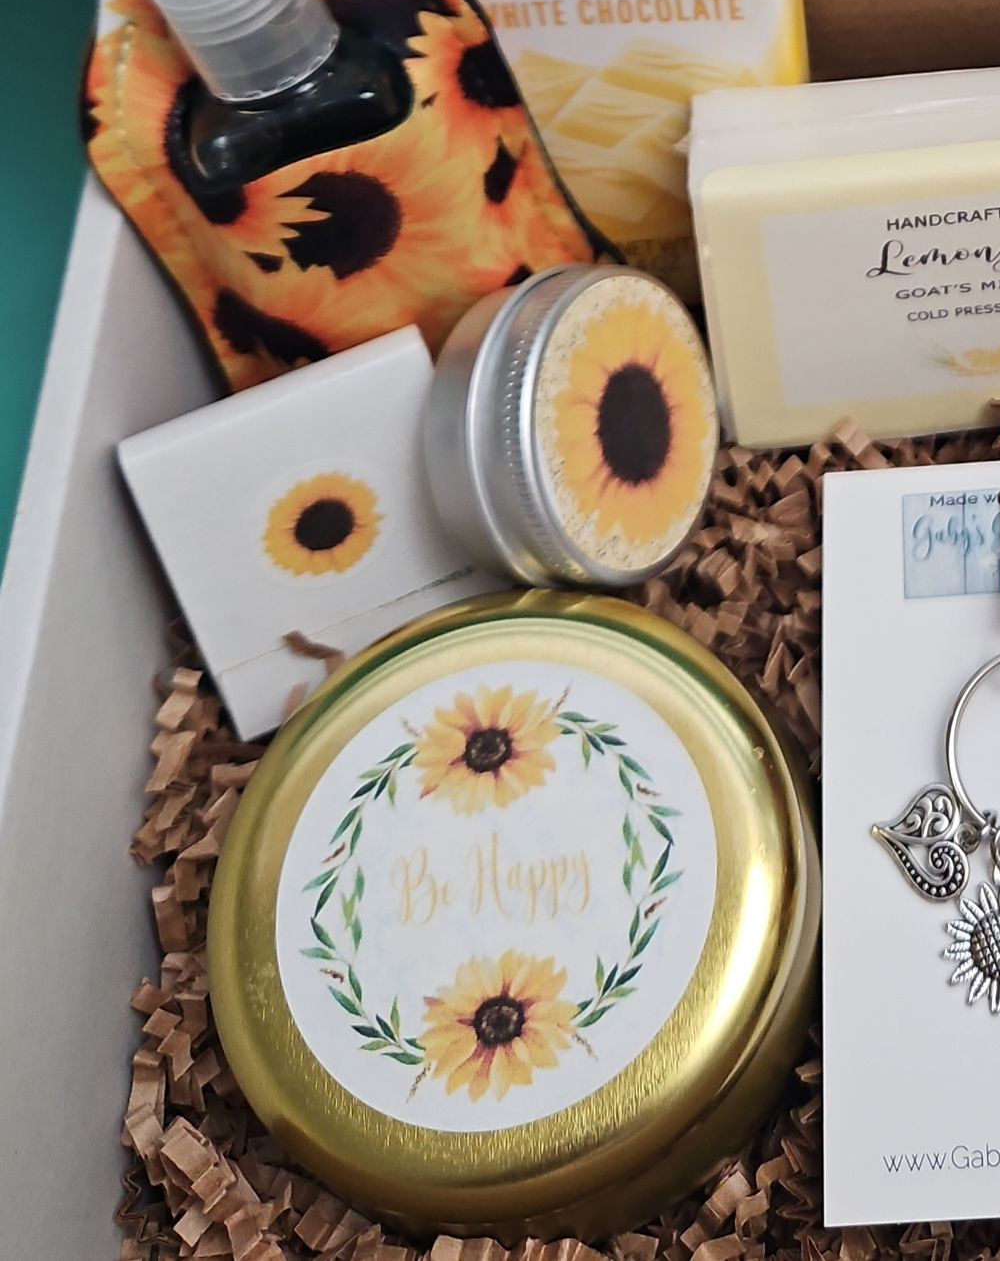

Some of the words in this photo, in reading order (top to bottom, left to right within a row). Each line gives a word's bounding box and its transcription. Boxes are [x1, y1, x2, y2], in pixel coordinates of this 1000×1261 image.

[895, 280, 973, 300] GOAT'S
[907, 308, 950, 323] COLD
[929, 492, 978, 507] Made
[391, 846, 456, 926] Be
[471, 832, 592, 925] Happy
